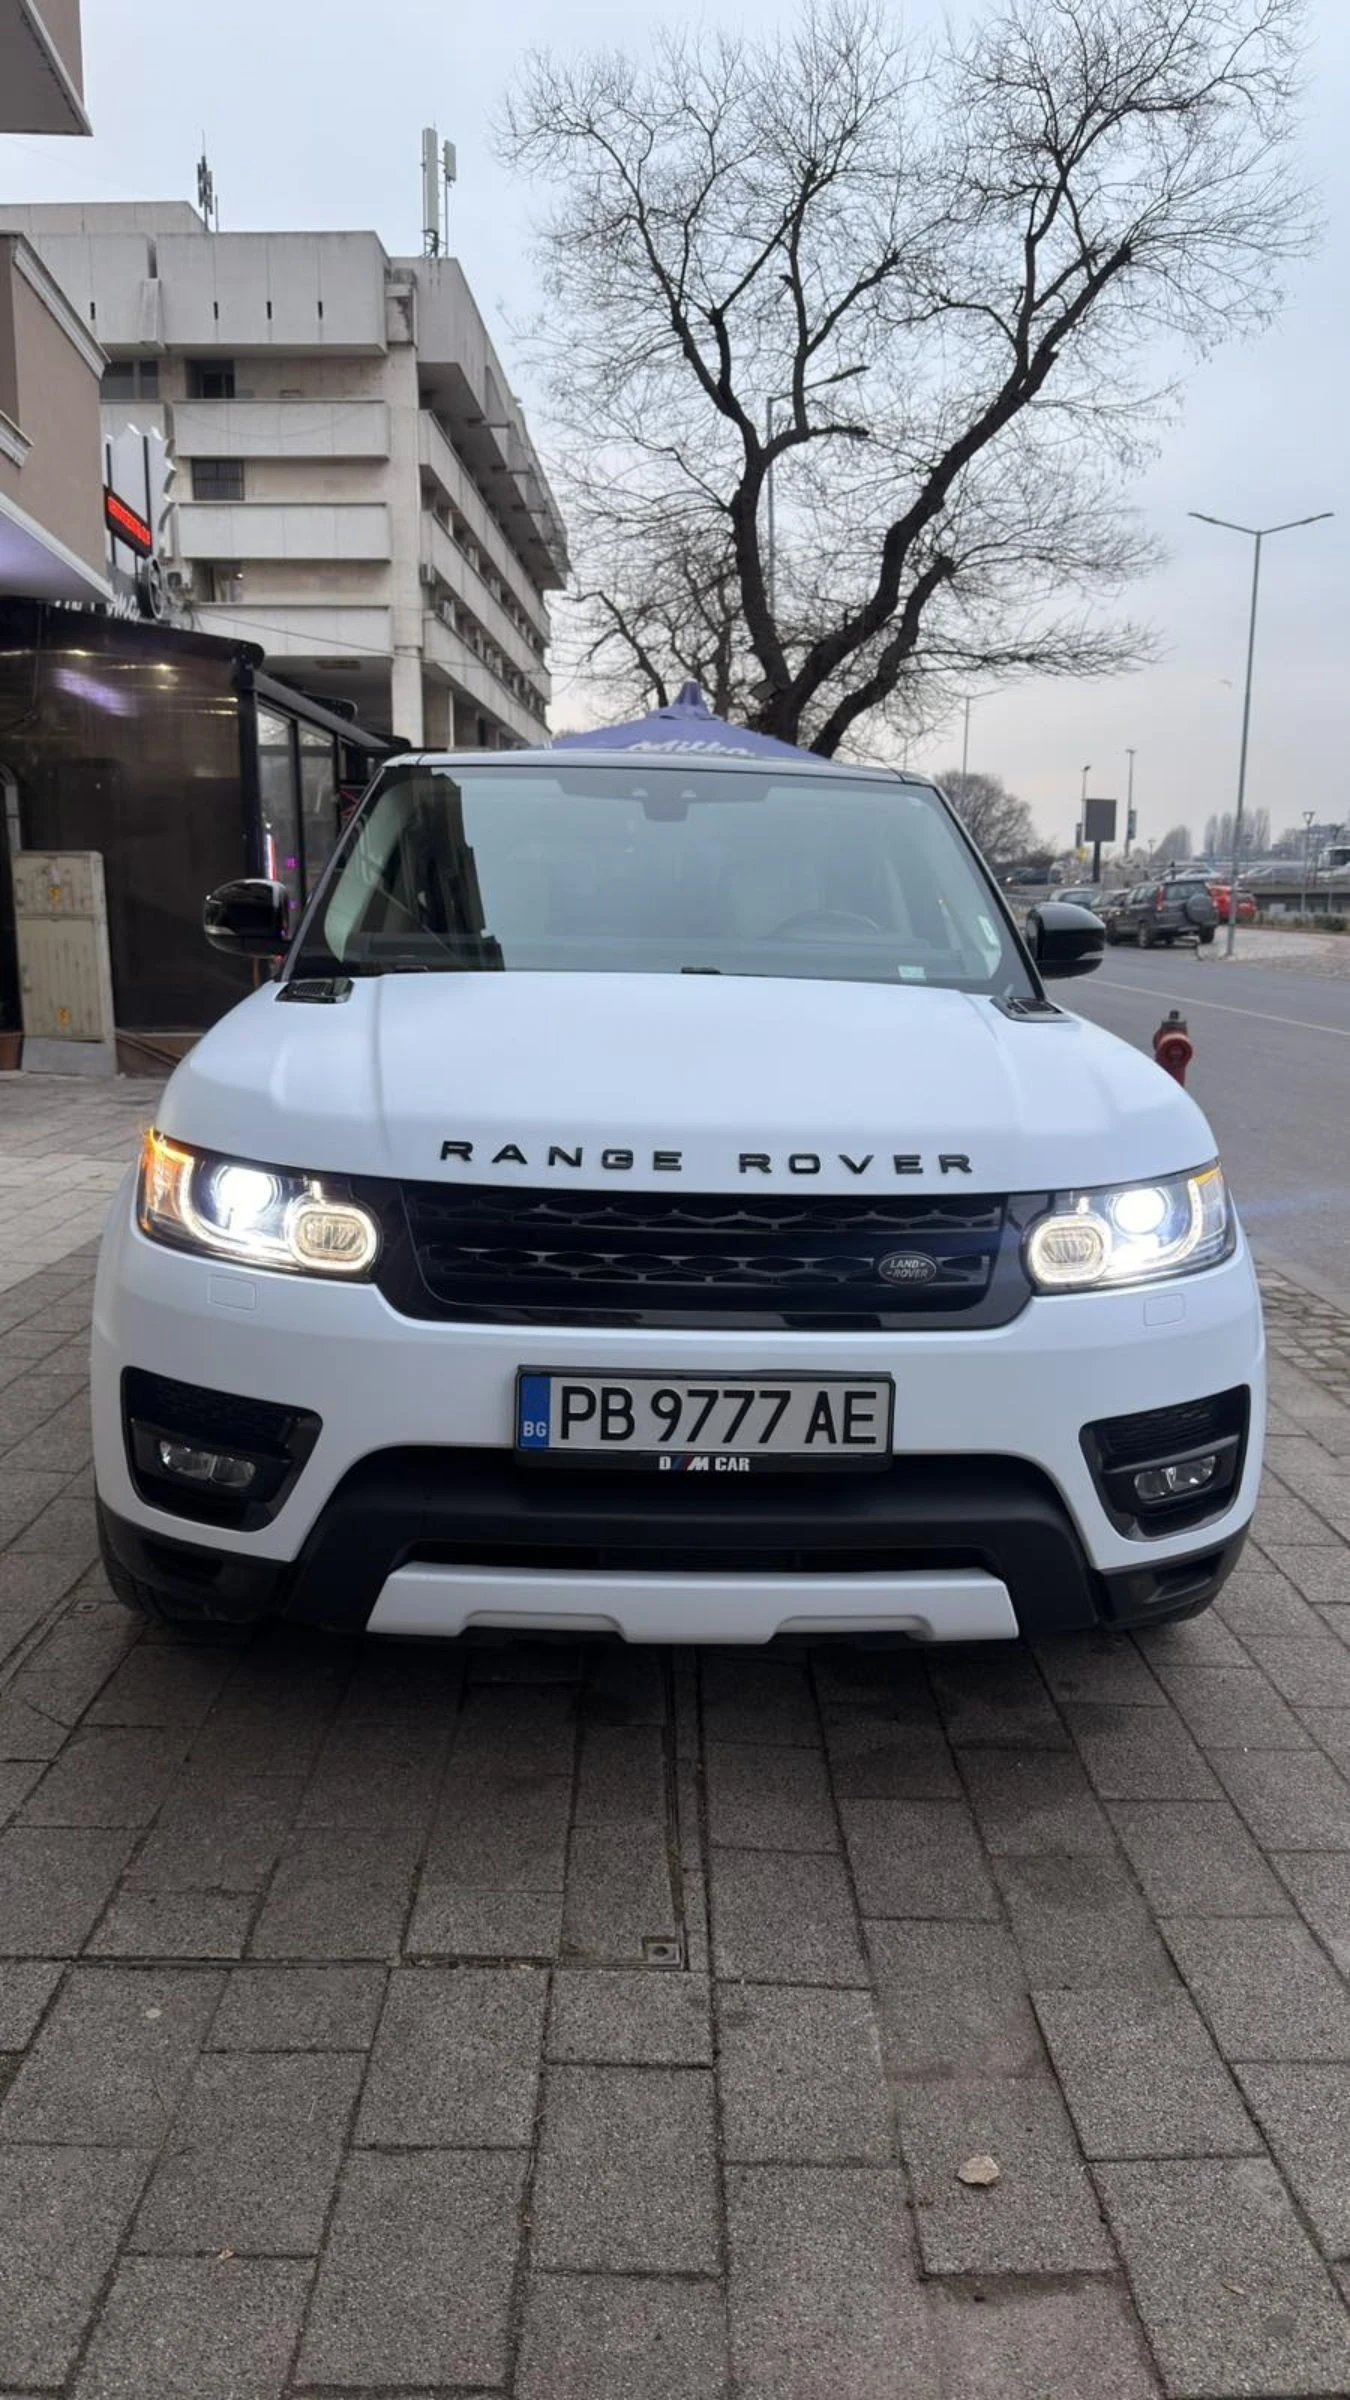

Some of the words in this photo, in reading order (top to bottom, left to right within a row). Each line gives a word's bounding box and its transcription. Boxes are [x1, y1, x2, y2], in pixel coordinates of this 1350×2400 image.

[440, 1140, 683, 1172] RANGE
[738, 1153, 973, 1175] ROVER
[560, 1385, 636, 1441] PB
[650, 1388, 792, 1444] 9777
[804, 1390, 877, 1445] AE
[523, 1420, 547, 1438] BG
[714, 1457, 750, 1472] CAR
